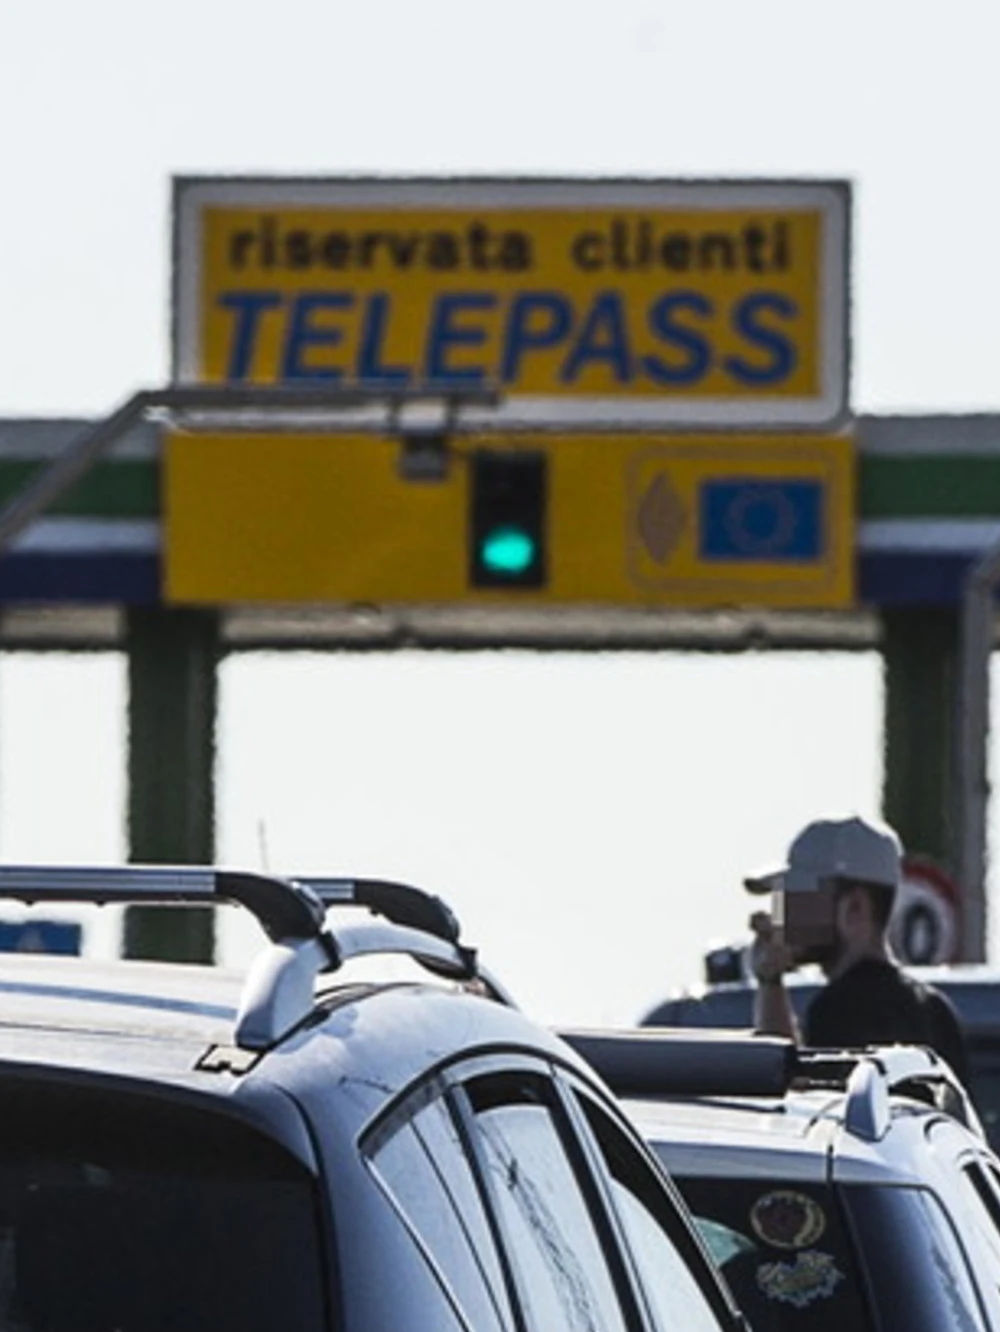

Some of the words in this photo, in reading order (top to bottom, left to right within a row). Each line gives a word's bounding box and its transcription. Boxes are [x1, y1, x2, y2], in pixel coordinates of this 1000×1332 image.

[228, 217, 534, 272] riservata
[572, 217, 792, 274] clienti
[217, 289, 799, 386] TELEPASS
